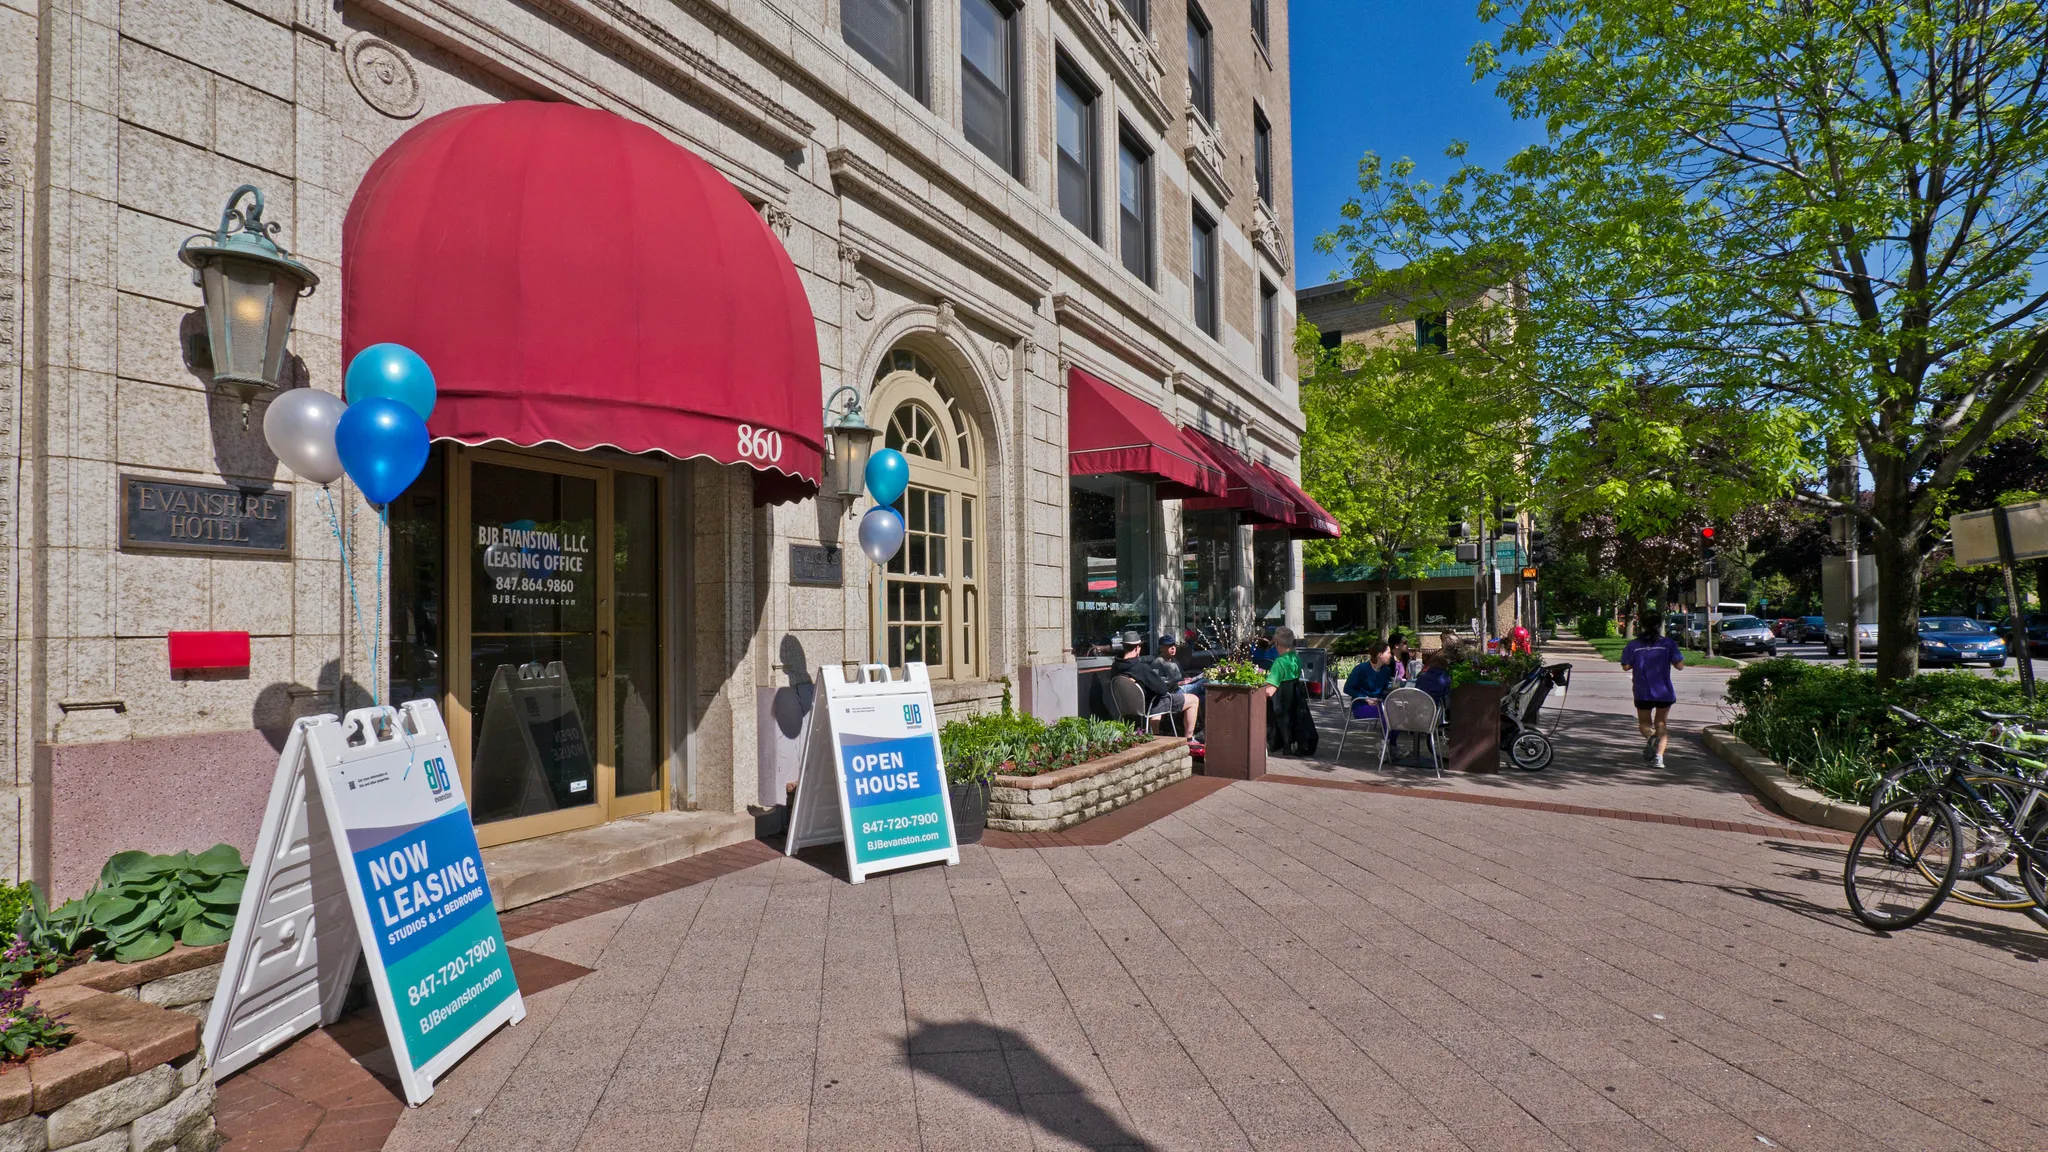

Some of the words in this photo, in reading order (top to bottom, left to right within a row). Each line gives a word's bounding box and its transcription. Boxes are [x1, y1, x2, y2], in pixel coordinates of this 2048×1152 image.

[737, 424, 782, 462] 860
[139, 487, 276, 520] EVANSHIRE
[171, 515, 249, 542] HOTEL
[479, 526, 499, 546] BJB
[503, 528, 560, 551] EVANSTON,
[564, 533, 588, 553] L.L.C.
[487, 551, 540, 570] LEASING
[543, 555, 583, 572] OFFICE
[496, 577, 573, 592] 847.864.9860
[492, 595, 575, 605] BJBEvanston.com
[852, 752, 903, 772] OPEN
[855, 772, 920, 795] HOUSE
[862, 812, 938, 834] 847-720-7900
[867, 832, 939, 850] BJBevanston.com
[368, 840, 429, 891] NOW
[378, 856, 479, 927] LEASING
[388, 917, 427, 945] STUDIOS
[428, 912, 436, 923] &
[437, 908, 444, 919] 1
[444, 887, 483, 915] BEDROOMS
[408, 936, 496, 1006] 847-720-7900
[419, 968, 502, 1035] BJBevanston.com
